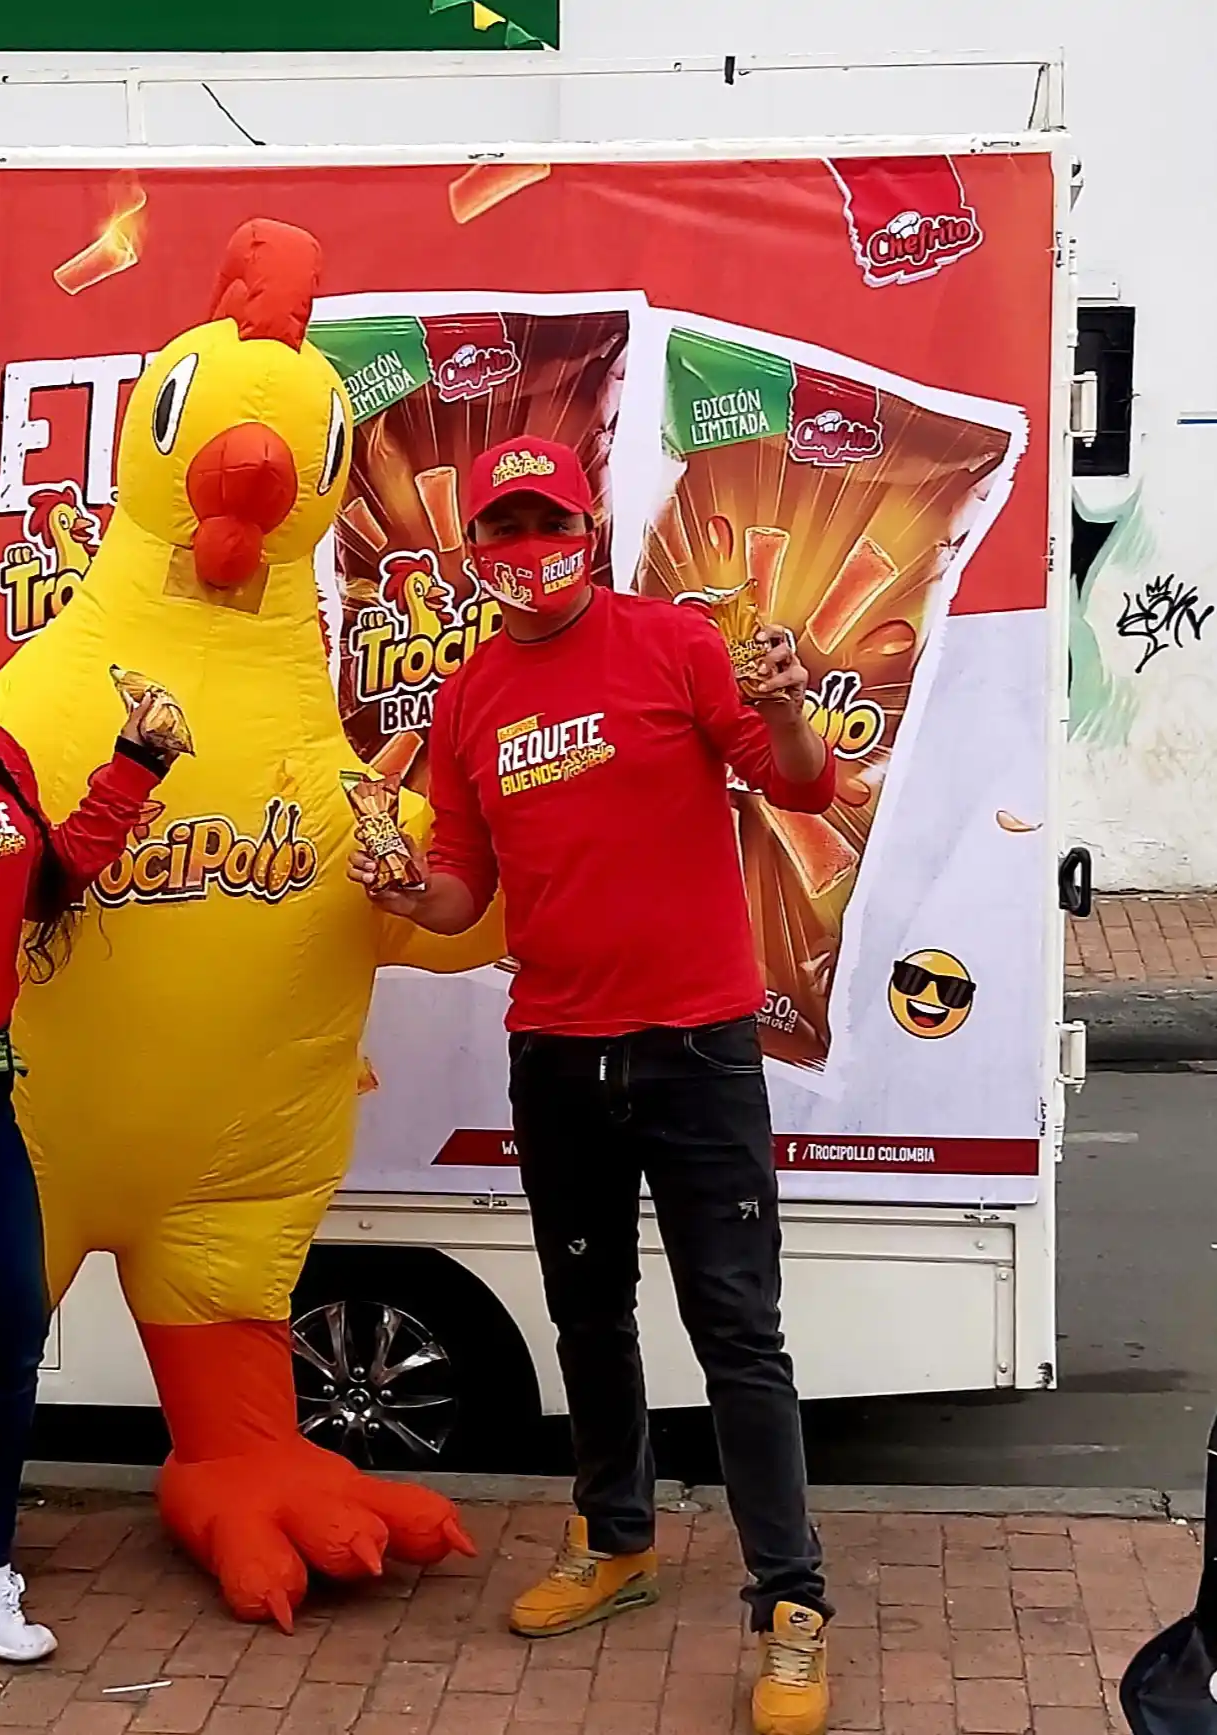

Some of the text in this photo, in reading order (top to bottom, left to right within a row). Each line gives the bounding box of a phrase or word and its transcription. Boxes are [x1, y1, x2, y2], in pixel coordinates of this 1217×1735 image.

[870, 217, 971, 263] Chefrito
[692, 387, 762, 423] EDICIÓN
[690, 411, 770, 446] LIMITADA
[497, 712, 605, 776] REQUETE
[500, 760, 562, 797] BUENOS
[96, 797, 308, 896] ociPollo
[877, 1146, 935, 1162] COLOMBIA
